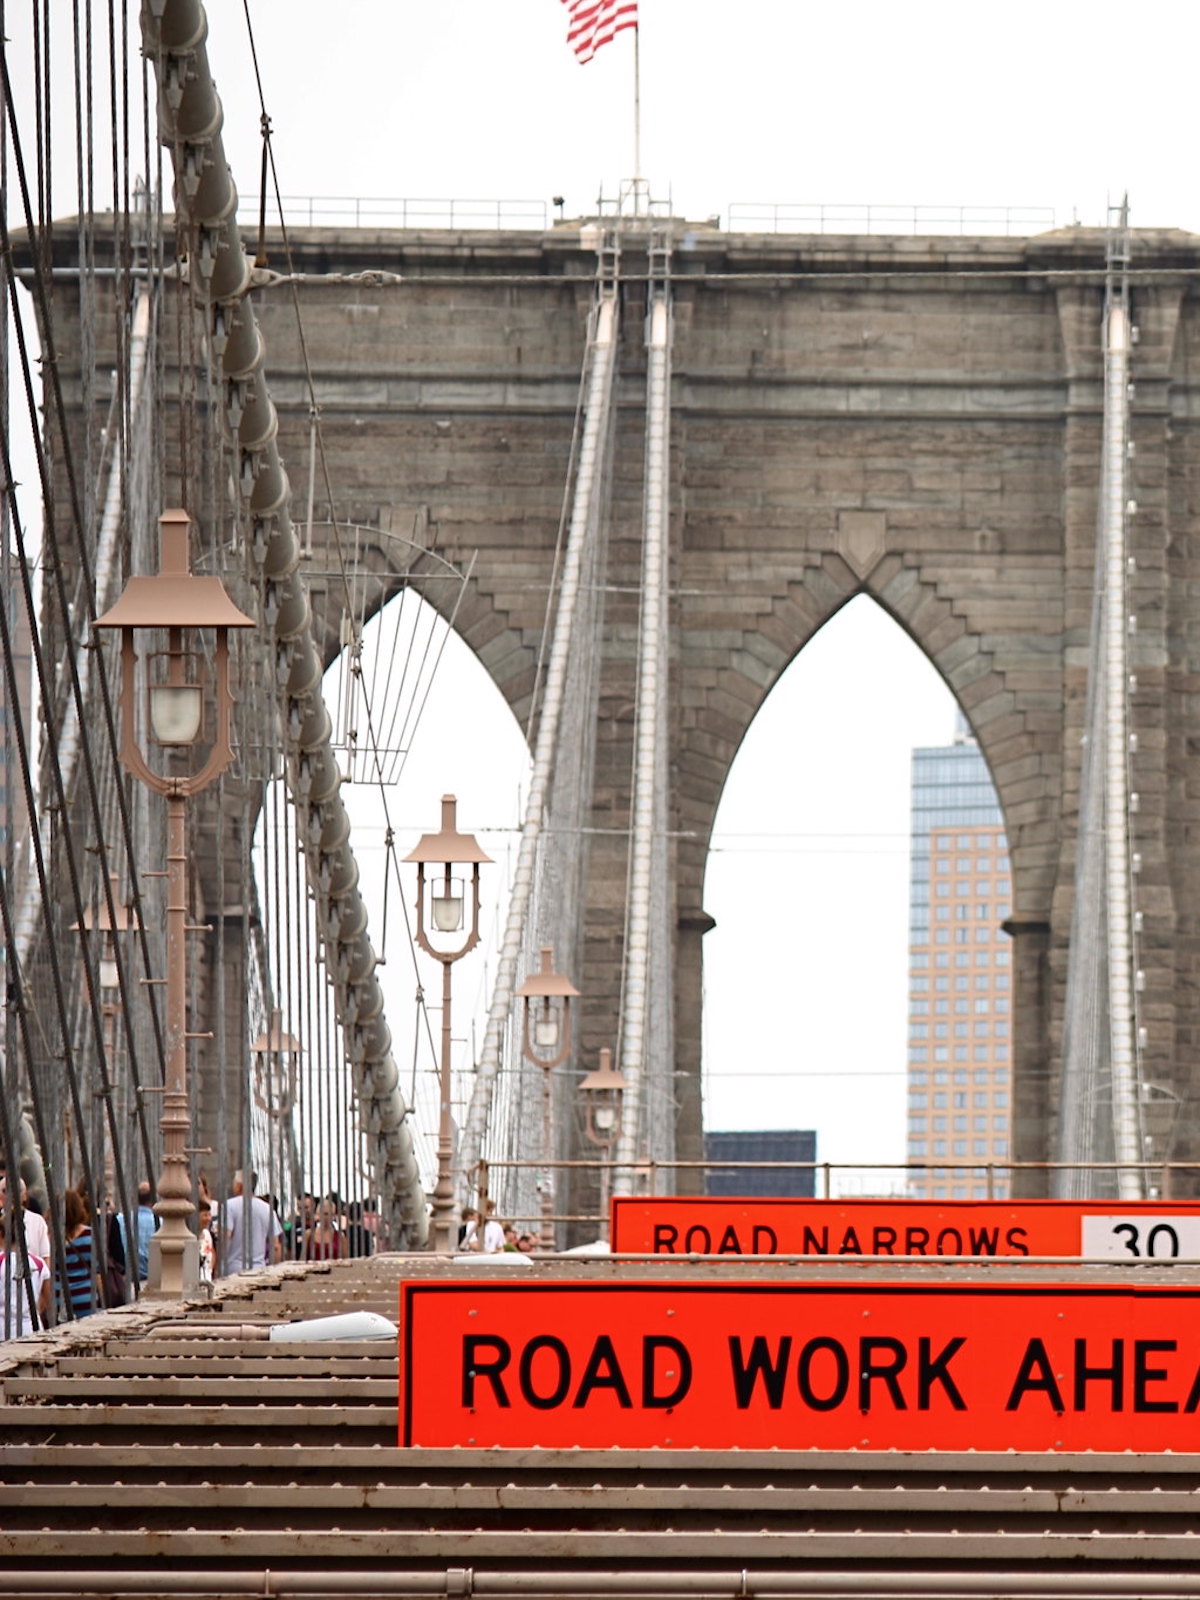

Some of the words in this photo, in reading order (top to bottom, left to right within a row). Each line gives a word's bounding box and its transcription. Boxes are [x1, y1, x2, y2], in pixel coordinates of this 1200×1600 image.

[654, 1224, 777, 1255] ROAD
[802, 1225, 1030, 1256] NARROWS
[1112, 1223, 1180, 1258] 30
[463, 1334, 693, 1411] ROAD
[728, 1336, 968, 1412] WORK
